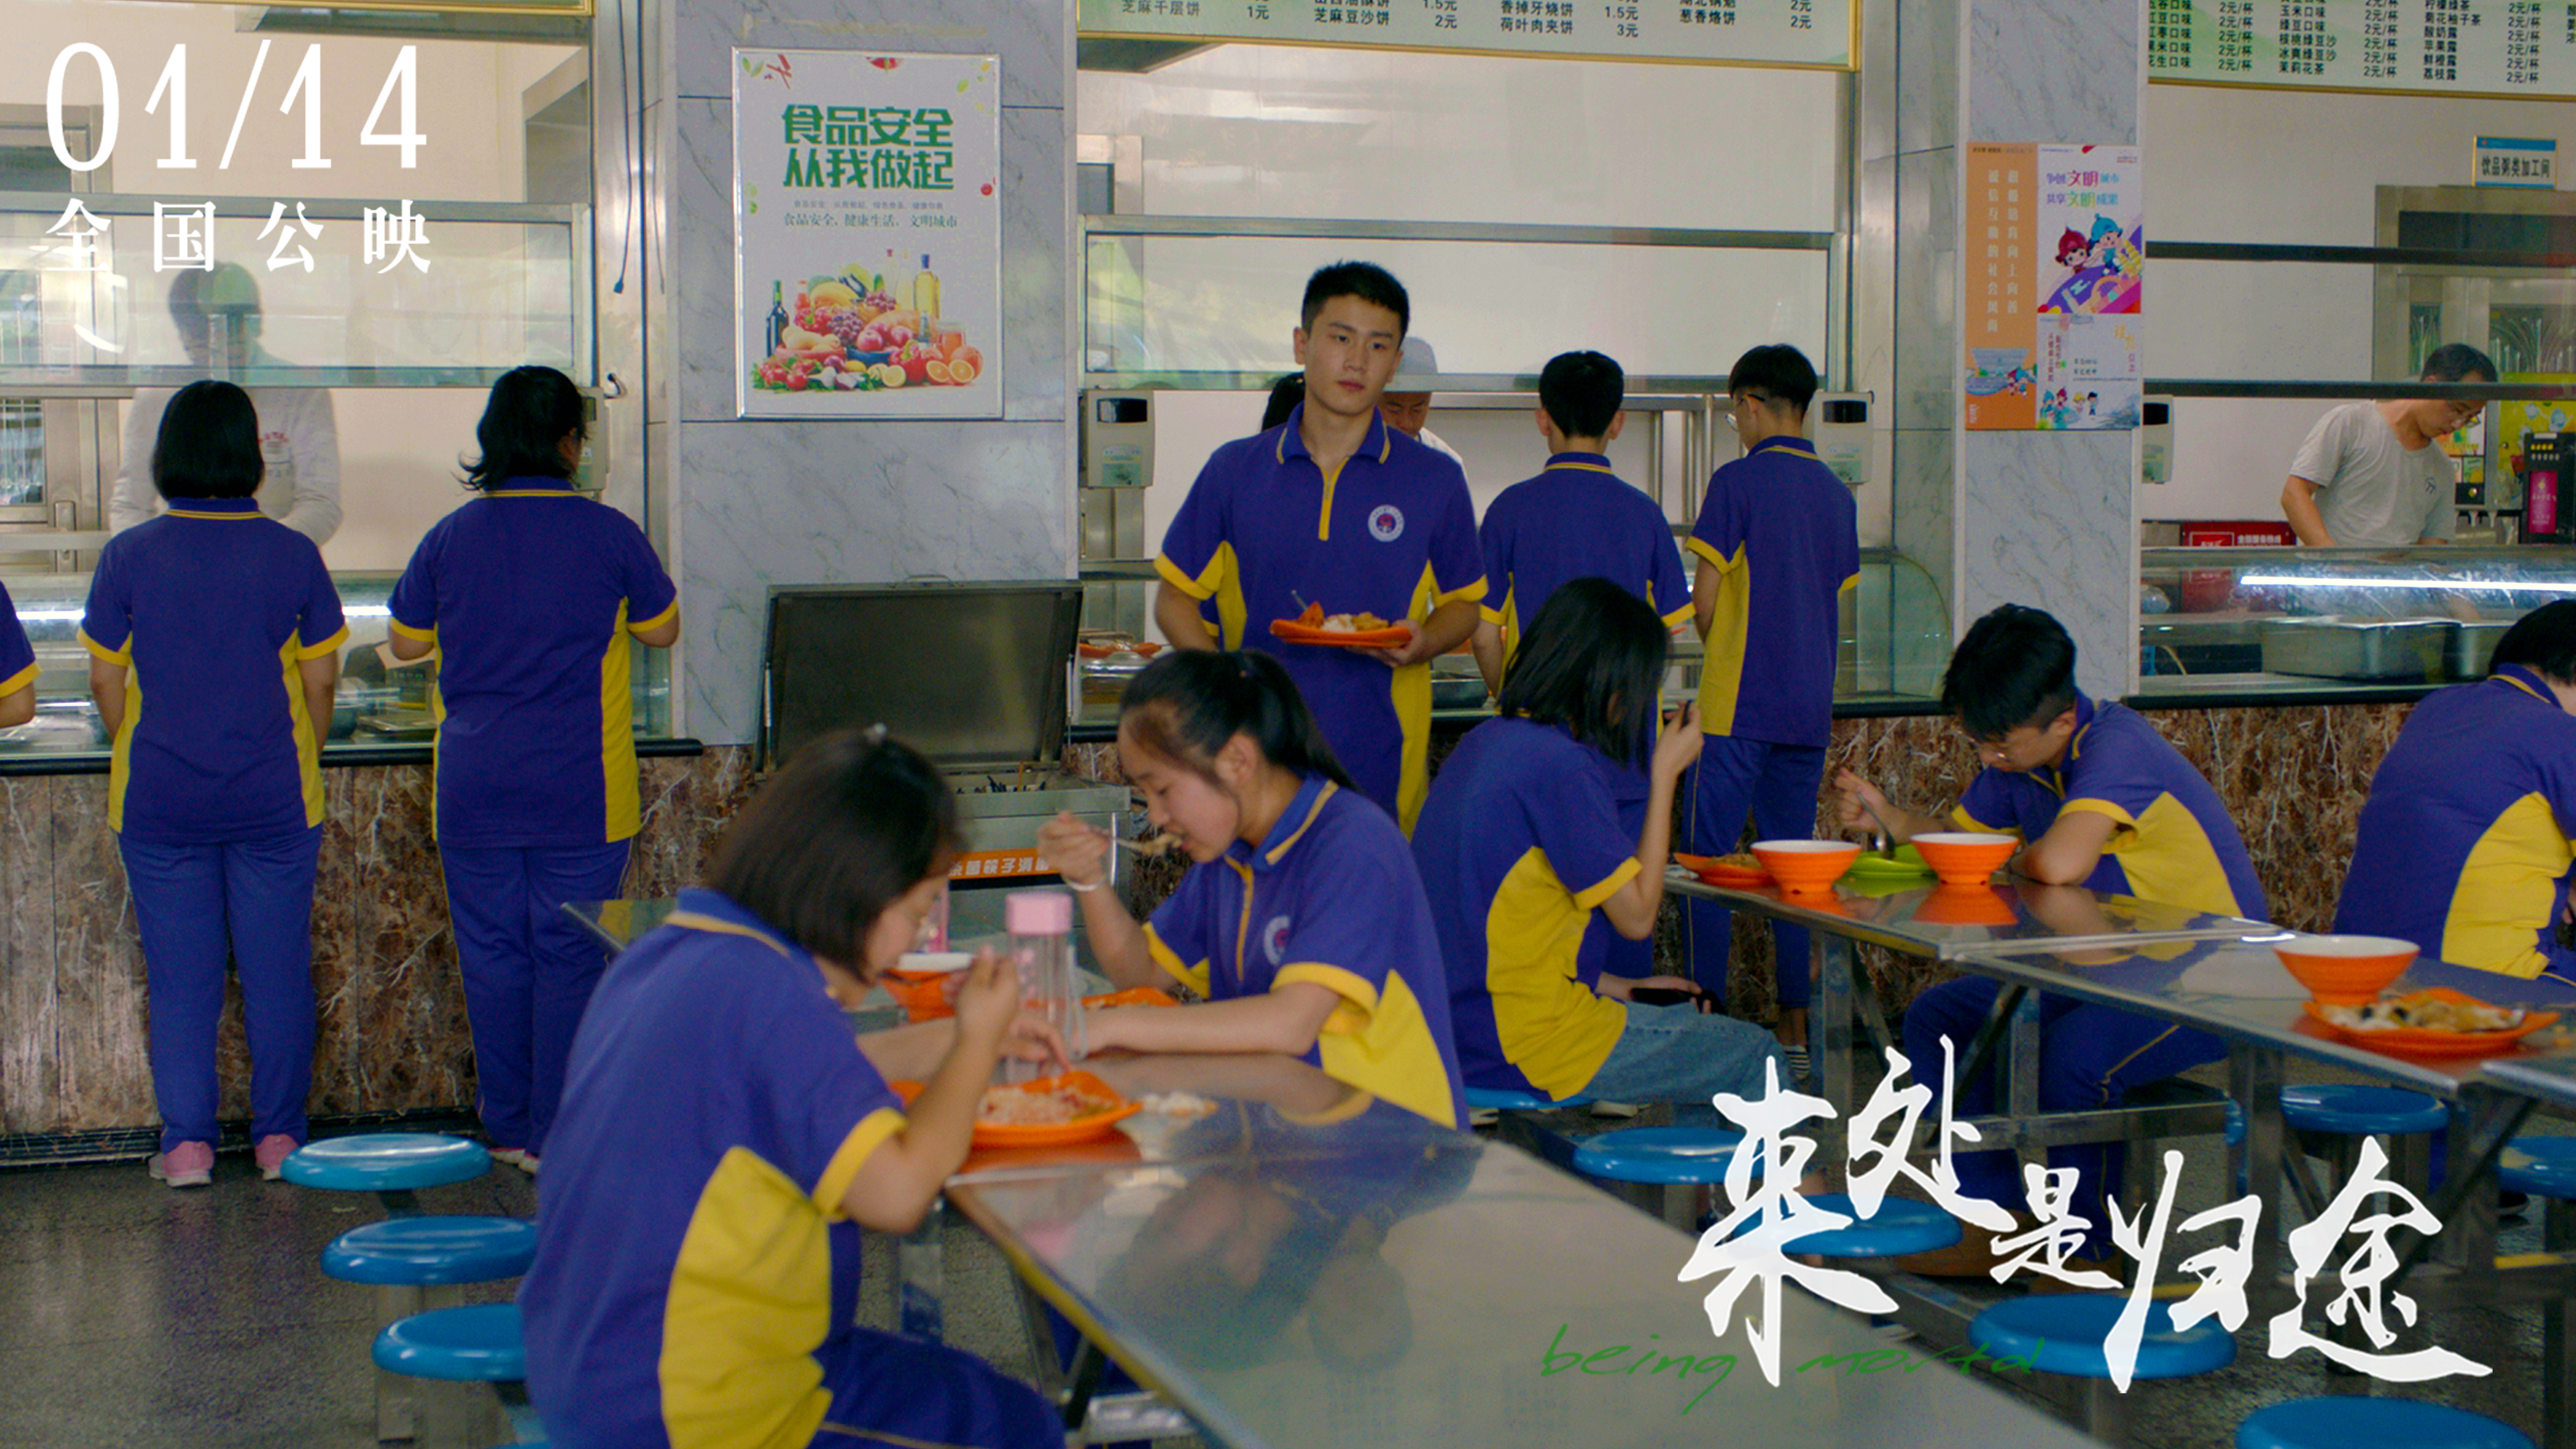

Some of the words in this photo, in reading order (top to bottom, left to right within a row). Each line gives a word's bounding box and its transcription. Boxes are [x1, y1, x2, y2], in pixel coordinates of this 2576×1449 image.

[1247, 5, 1269, 20] 1元
[1605, 6, 1638, 20] 1.5元
[2509, 2, 2541, 15] 2元/杯
[1315, 7, 1390, 26] 芝麻豆沙饼
[1435, 14, 1458, 28] 2元
[1790, 15, 1812, 29] 2元
[2219, 15, 2253, 29] 2元/杯
[2365, 9, 2398, 22] 2元/杯
[1501, 16, 1573, 35] 荷叶肉夹饼
[1617, 24, 1638, 38] 3元
[2509, 16, 2540, 29] 2元/杯
[2365, 23, 2398, 36] 2元/杯
[2219, 30, 2253, 43] 2元/杯
[2508, 30, 2540, 43] 2元/杯
[2364, 37, 2397, 50] 2元/杯
[2219, 44, 2252, 57] 2元/杯
[2508, 44, 2540, 57] 2元/杯
[2364, 51, 2397, 64] 2元/杯
[2218, 58, 2252, 72] 2元/杯
[2507, 58, 2539, 71] 2元/杯
[2364, 65, 2397, 78] 2元/杯
[2507, 71, 2539, 84] 2元/杯
[782, 105, 953, 147] 食品安全
[783, 147, 954, 190] 从我做起
